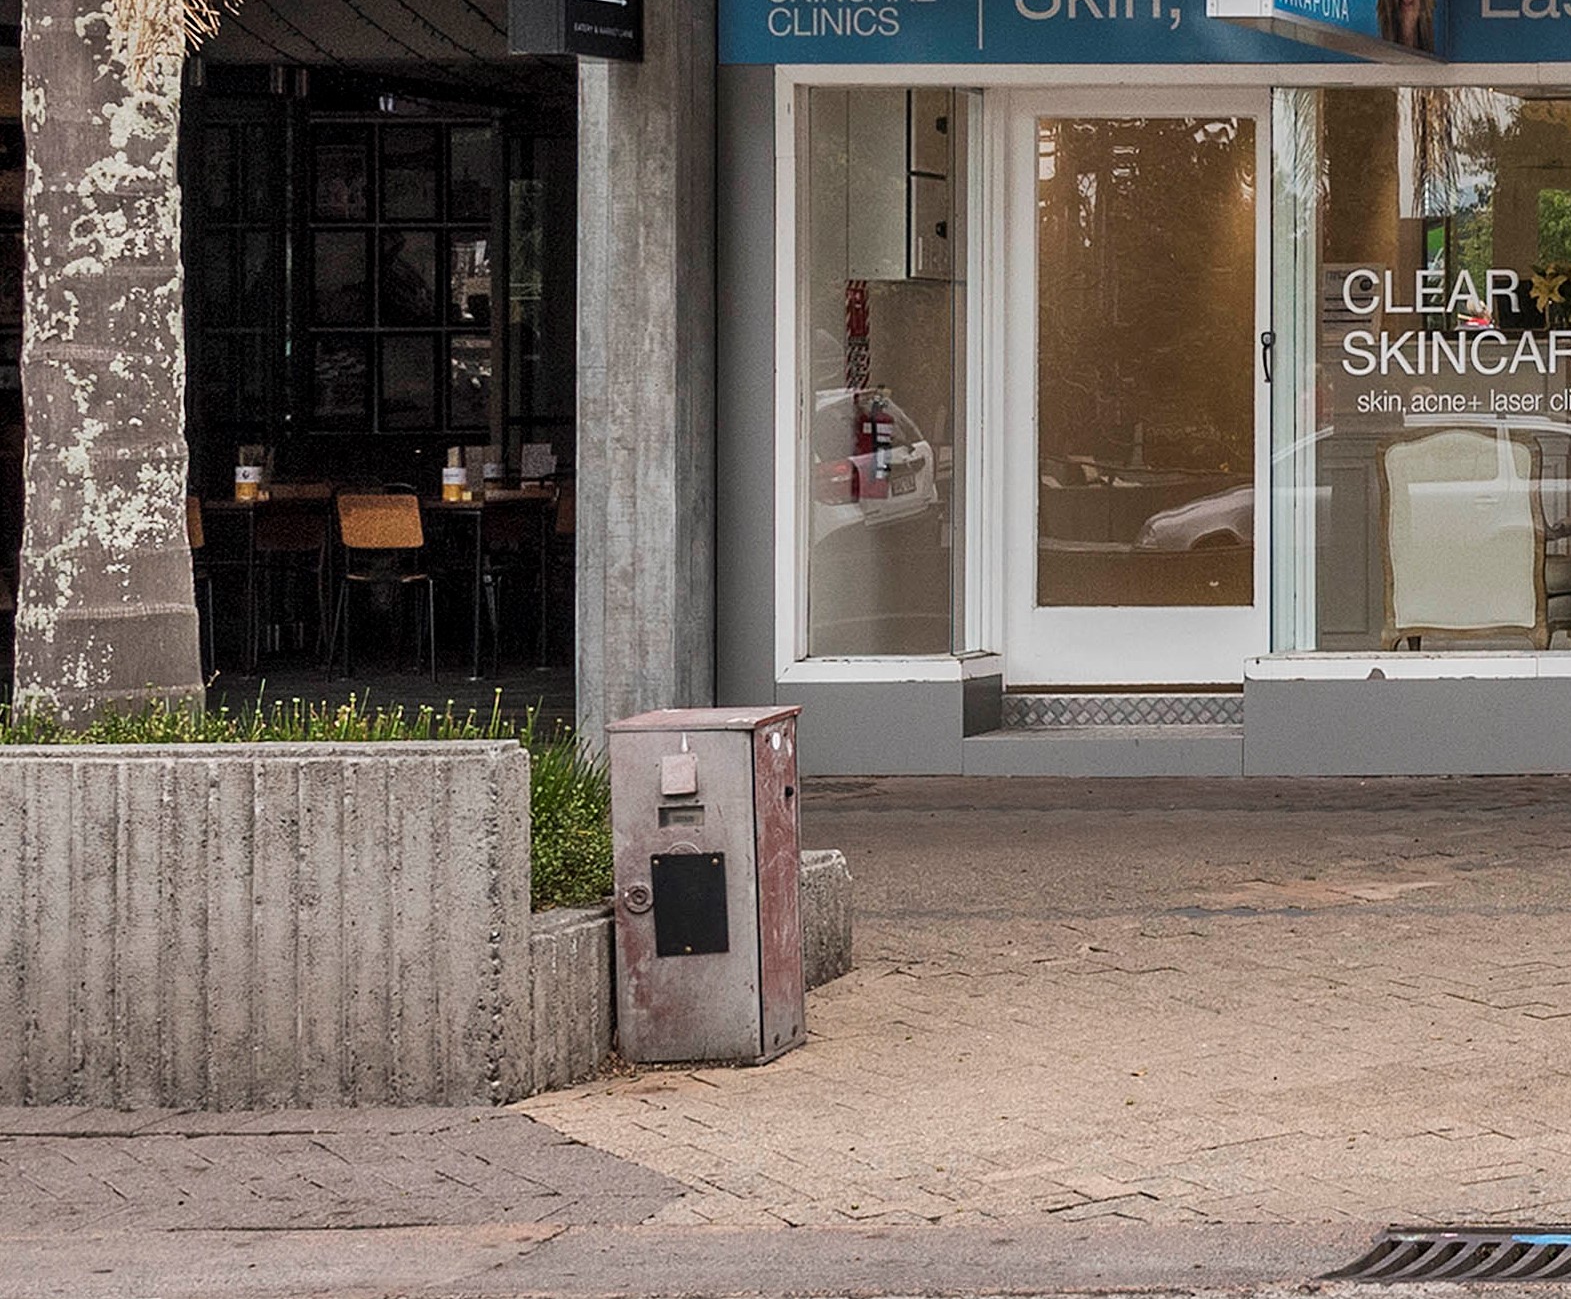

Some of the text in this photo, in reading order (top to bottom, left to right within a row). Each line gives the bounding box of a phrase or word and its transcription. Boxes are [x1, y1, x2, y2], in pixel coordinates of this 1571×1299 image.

[766, 5, 900, 38] CLINICS
[1341, 268, 1521, 315] CLEAR
[1489, 388, 1543, 413] laser
